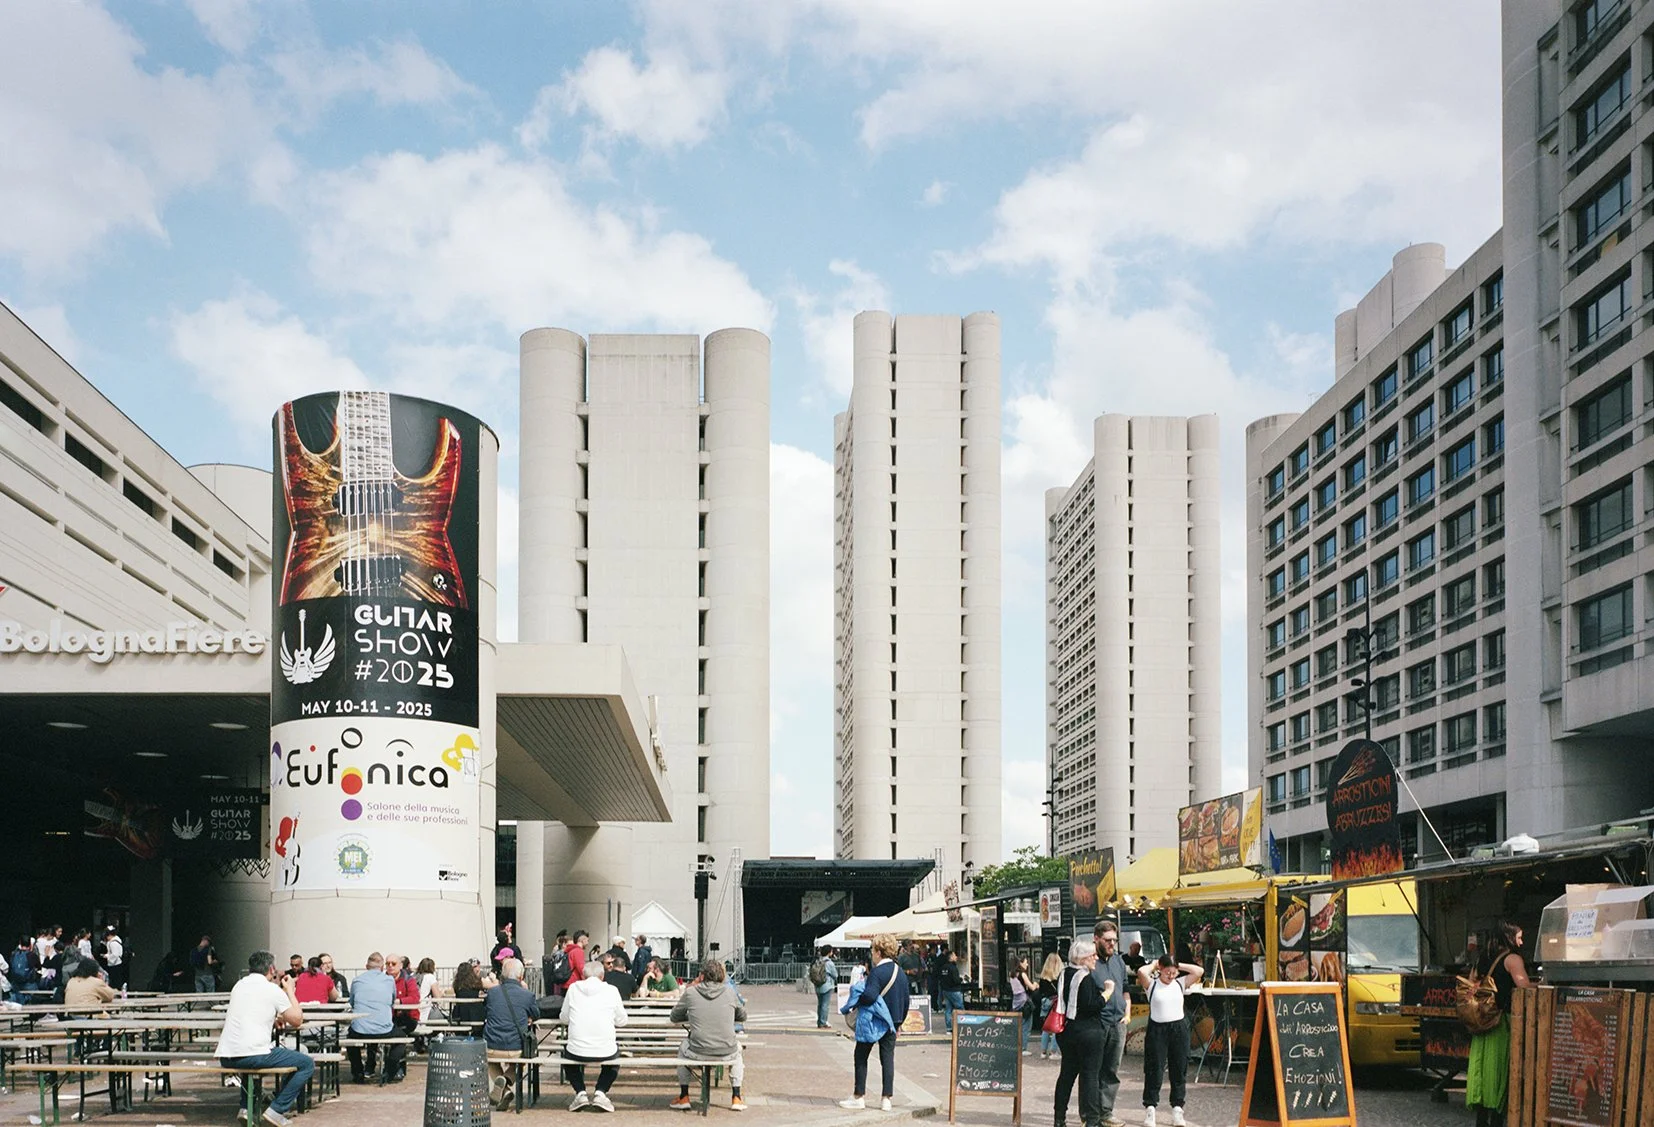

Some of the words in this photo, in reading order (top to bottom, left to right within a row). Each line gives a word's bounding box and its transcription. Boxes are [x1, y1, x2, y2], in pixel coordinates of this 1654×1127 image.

[354, 604, 453, 634] GUITAR
[0, 619, 266, 664] BolognaFiere
[354, 629, 453, 659] SHOW
[301, 700, 331, 715] MAY
[335, 699, 379, 714] 10-11
[396, 701, 433, 717] 2025
[210, 795, 231, 803] MAY
[234, 795, 259, 803] 10-11
[210, 809, 251, 818] GUITAR
[367, 802, 401, 811] Salone
[404, 803, 428, 812] della
[430, 805, 460, 815] musica
[210, 819, 251, 829] SHOW
[376, 813, 401, 821] delle
[422, 816, 468, 825] professioni
[1424, 988, 1457, 1006] ARROS
[1276, 999, 1289, 1017] LA
[1292, 1001, 1325, 1015] CASA
[958, 1026, 972, 1037] LA
[975, 1026, 1005, 1037] CASA
[969, 1052, 996, 1063] CREA
[1288, 1044, 1324, 1058] CREA
